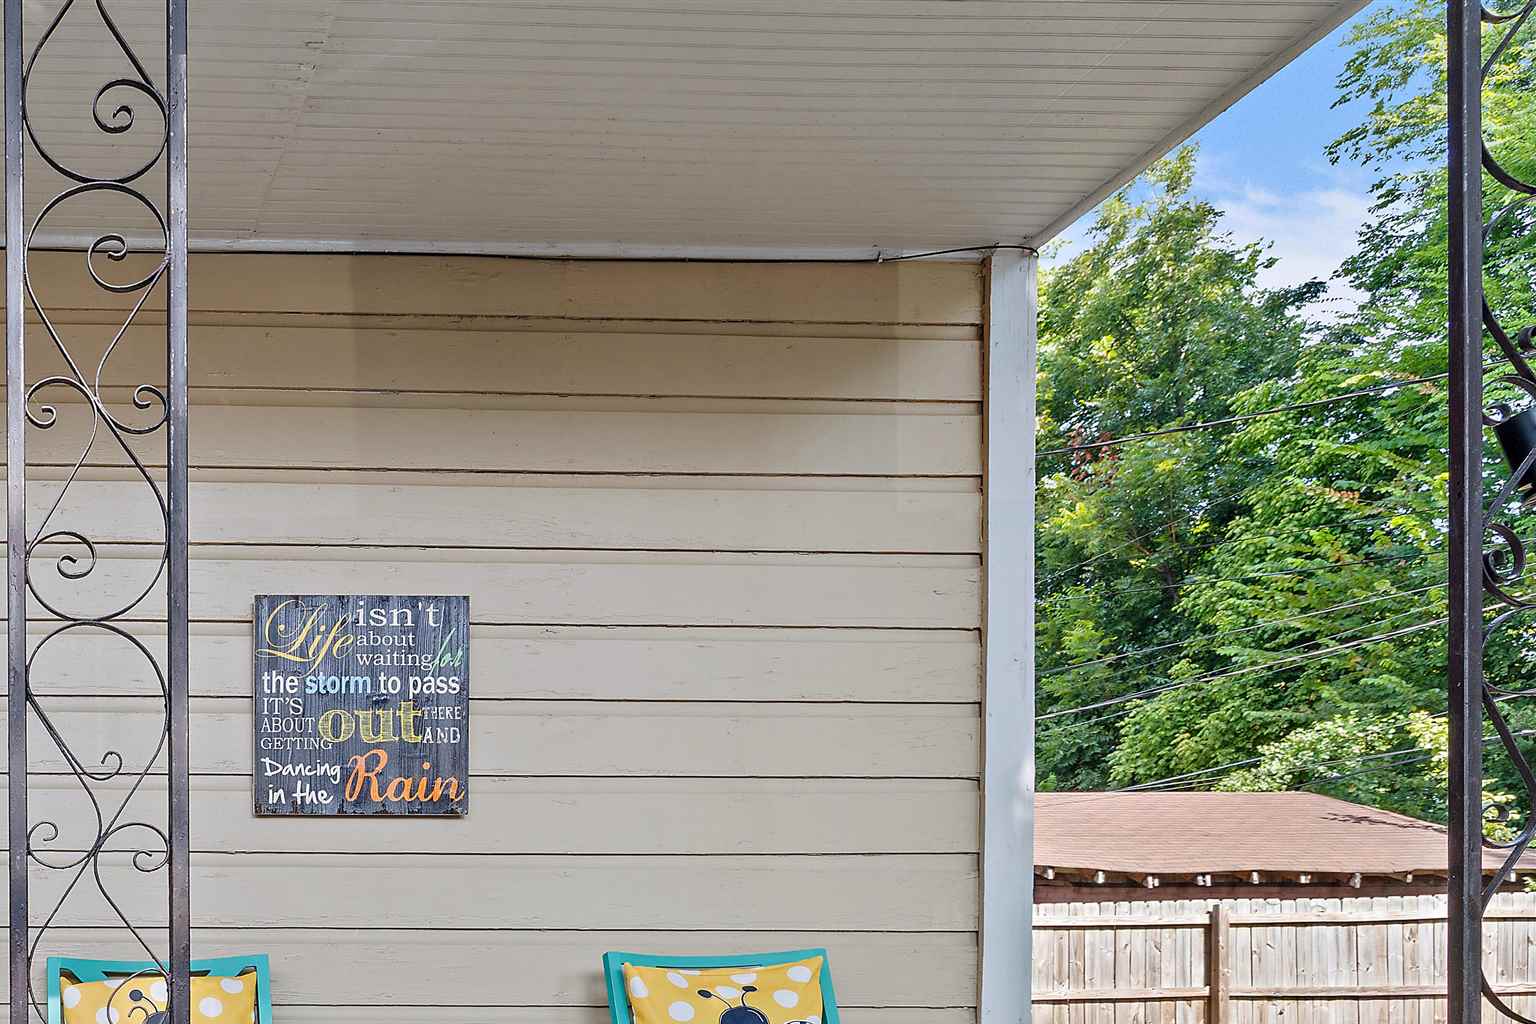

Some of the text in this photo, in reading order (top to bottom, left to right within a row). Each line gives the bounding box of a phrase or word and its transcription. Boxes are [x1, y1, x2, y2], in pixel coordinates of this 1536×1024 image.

[256, 599, 440, 678] Life isn't
[357, 631, 415, 646] about
[357, 628, 463, 677] waiting for
[262, 671, 460, 699] the storm to pass
[263, 697, 303, 715] IT'S
[423, 706, 461, 720] THERE
[261, 717, 315, 733] ABOUT
[319, 700, 422, 743] out
[261, 737, 333, 750] GETTING
[423, 727, 461, 744] AND
[261, 757, 341, 784] Dancing
[345, 748, 464, 802] Rain
[268, 780, 333, 804] in the
